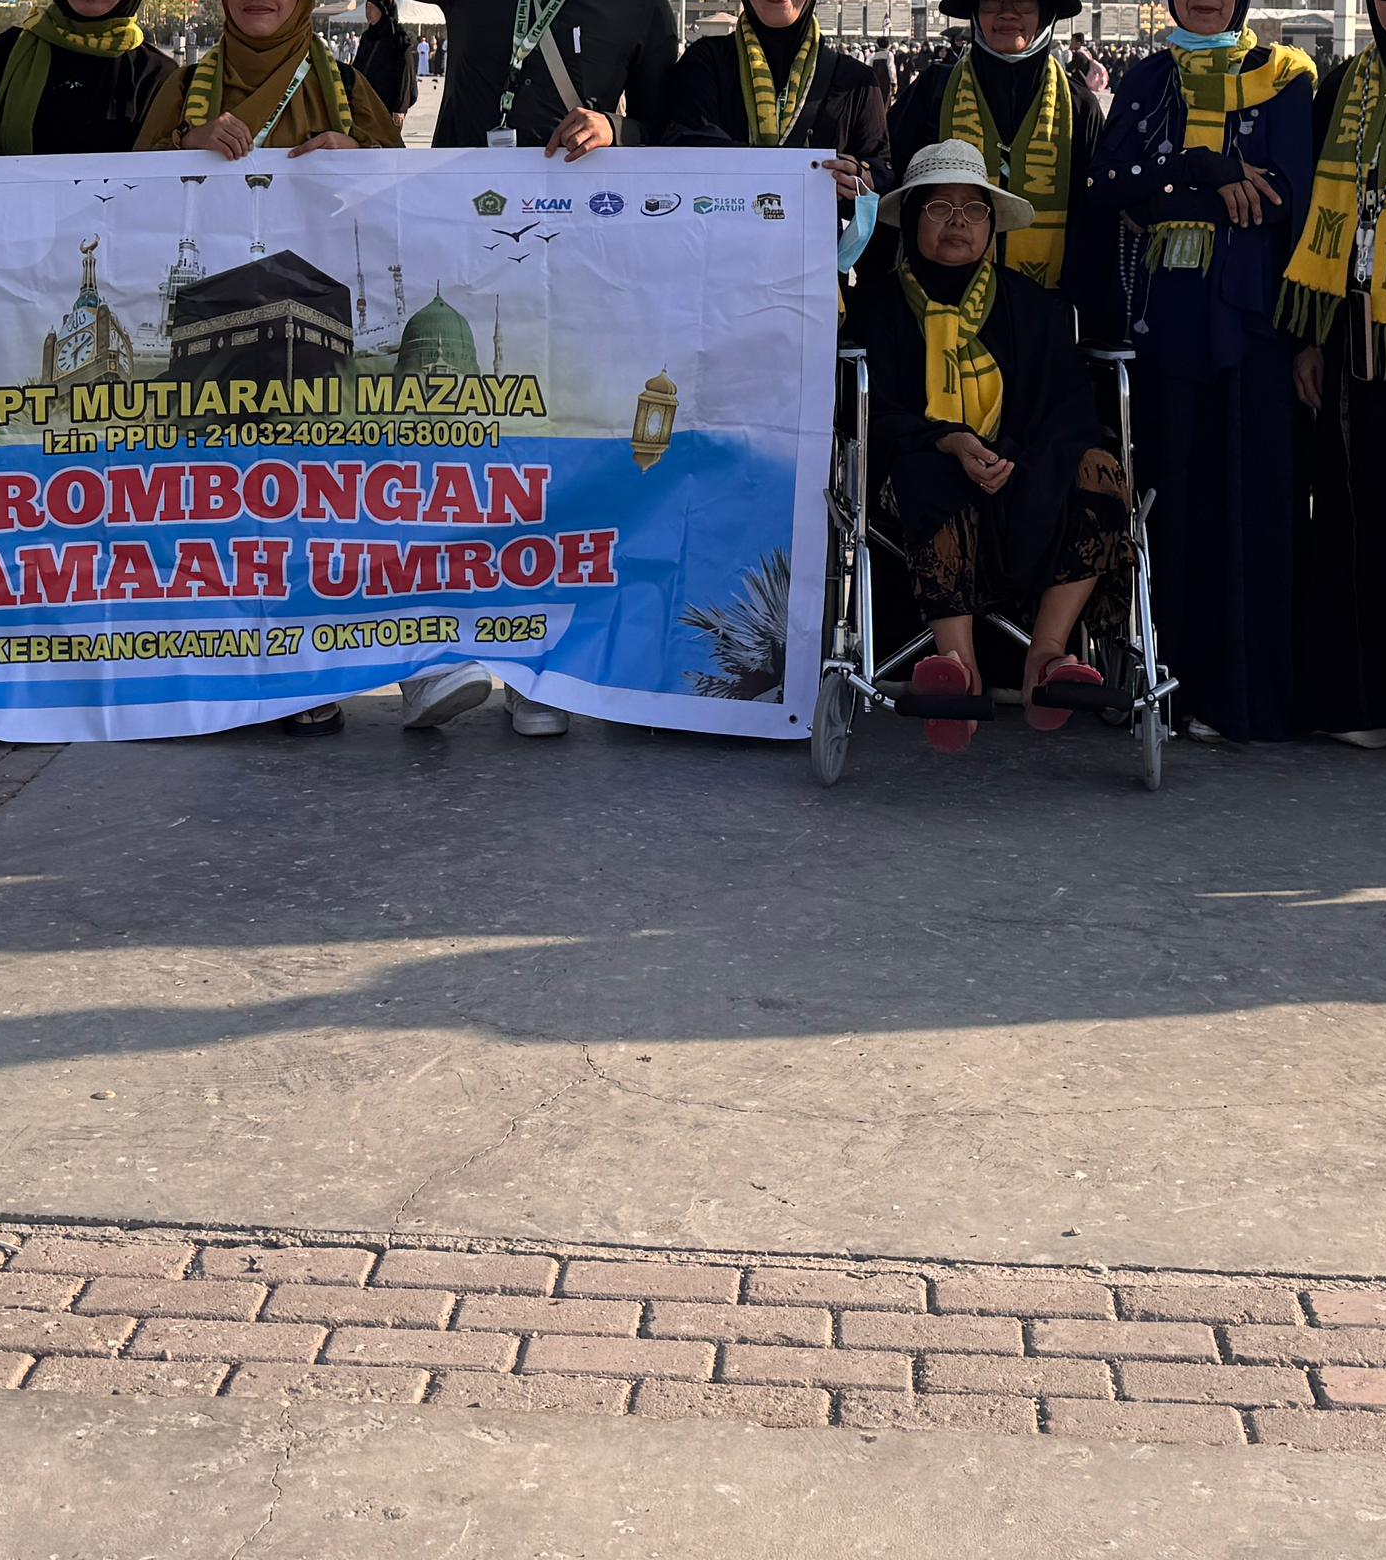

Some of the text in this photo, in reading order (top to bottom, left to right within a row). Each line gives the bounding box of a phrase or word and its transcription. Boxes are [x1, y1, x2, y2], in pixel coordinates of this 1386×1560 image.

[534, 198, 572, 210] KAN
[714, 204, 745, 212] PATUH
[1308, 205, 1349, 260] M
[71, 376, 341, 422] MUTIARANI
[356, 373, 548, 417] MAZAYA
[43, 428, 97, 455] Izin
[105, 423, 179, 452] PPIU
[203, 420, 500, 449] 21032402401580001
[305, 527, 619, 601] UMROH
[266, 626, 305, 656] 27
[312, 615, 459, 652] OKTOBER
[475, 614, 548, 642] 2025
